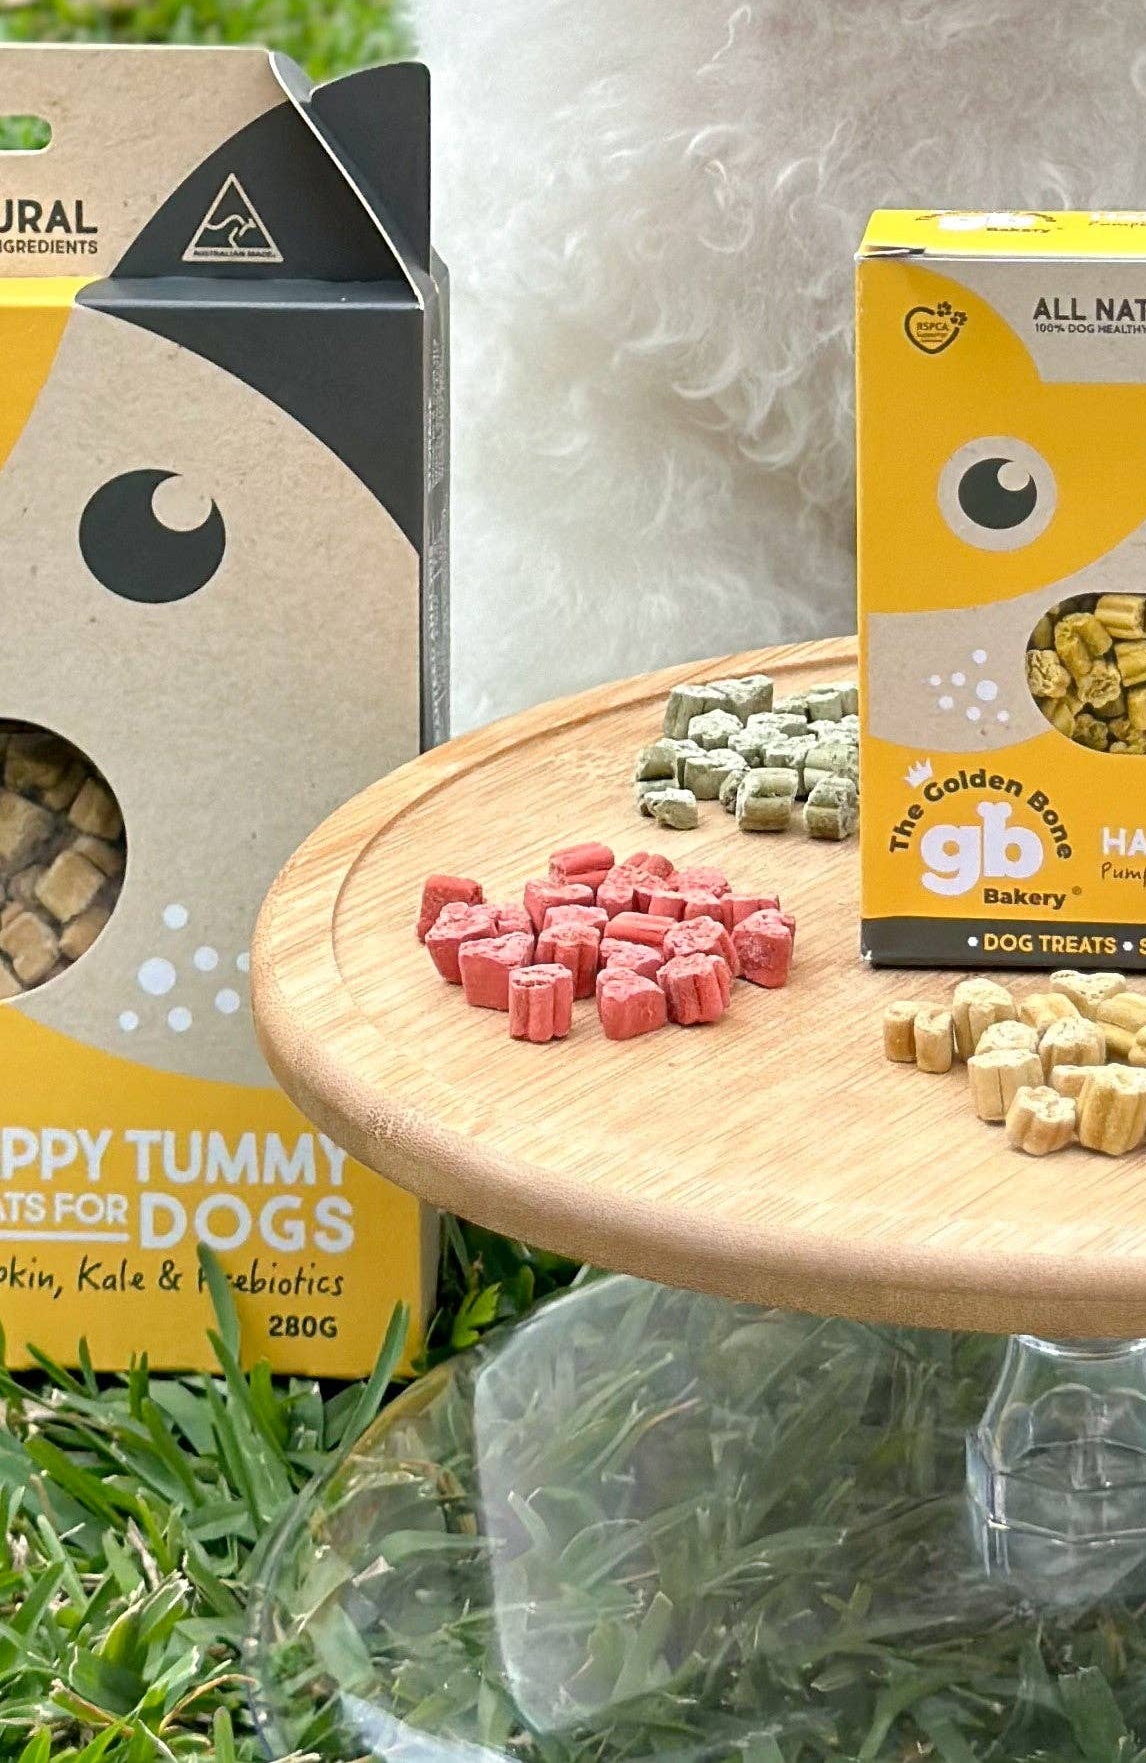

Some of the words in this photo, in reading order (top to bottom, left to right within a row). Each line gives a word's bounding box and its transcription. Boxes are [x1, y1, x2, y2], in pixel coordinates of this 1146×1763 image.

[0, 239, 98, 255] GREDIENTS
[1033, 297, 1087, 321] ALL
[1035, 323, 1066, 334] 100%
[1067, 323, 1095, 335] DOG
[888, 803, 925, 854] The
[923, 768, 1024, 803] Golden
[1026, 789, 1073, 860] Bone
[920, 801, 1045, 896] gb
[983, 888, 1067, 910] Bakery
[982, 932, 1034, 953] DOG
[1038, 934, 1118, 955] TREATS
[0, 1126, 113, 1182] PPY
[123, 1129, 347, 1187] TUMMY
[54, 1191, 129, 1226] FOR
[139, 1191, 355, 1254] DOGS
[77, 1253, 146, 1292] Kale
[158, 1259, 183, 1292] &
[198, 1257, 345, 1297] ebiotics
[268, 1313, 339, 1339] 280G
